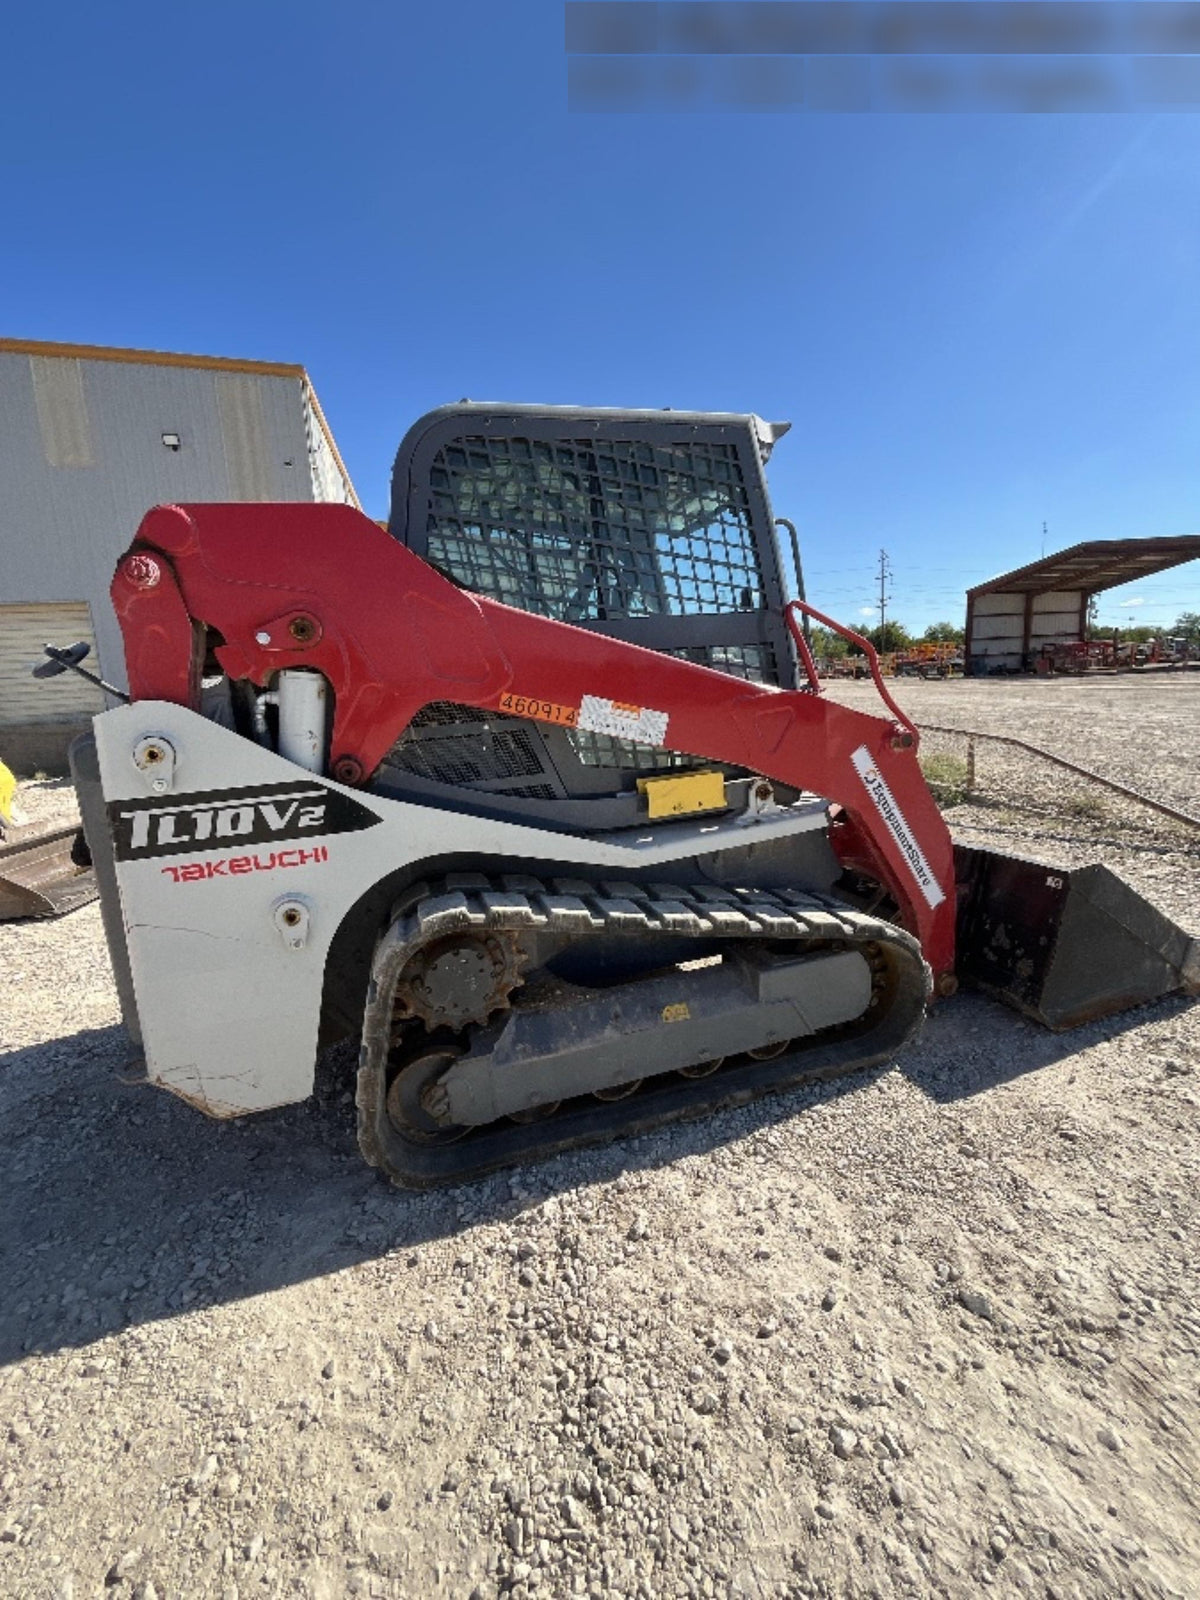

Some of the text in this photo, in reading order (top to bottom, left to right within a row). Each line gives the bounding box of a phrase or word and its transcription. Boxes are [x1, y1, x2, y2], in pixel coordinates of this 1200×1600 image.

[502, 694, 576, 724] 460914
[871, 782, 931, 886] EquipmentShare
[161, 846, 329, 884] TAKEUCHI
